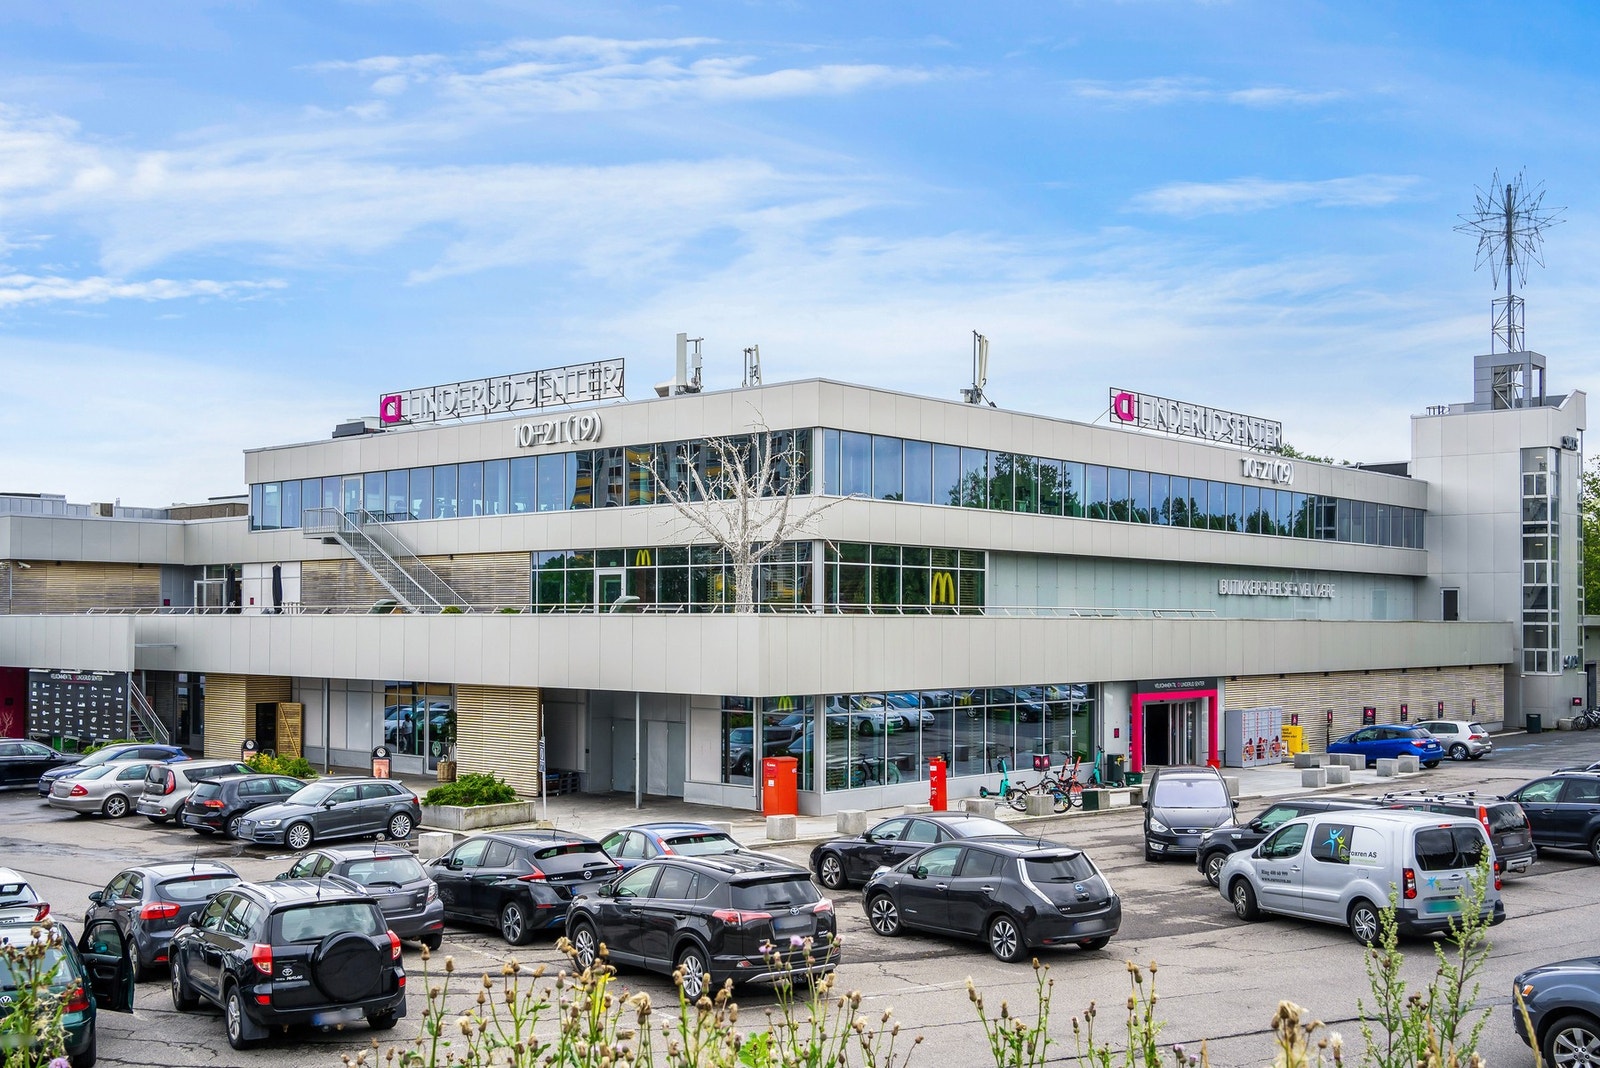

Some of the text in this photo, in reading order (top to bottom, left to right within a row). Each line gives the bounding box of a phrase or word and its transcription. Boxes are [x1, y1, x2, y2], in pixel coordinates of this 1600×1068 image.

[407, 378, 518, 421] LINDERUD
[524, 363, 622, 406] SENTER
[513, 411, 603, 448] 10-21 (19)
[1139, 395, 1283, 449] LINDERUD SENTER
[1218, 579, 1262, 596] BUTIKKER
[1267, 580, 1294, 597] HELSE
[1367, 851, 1378, 859] AS
